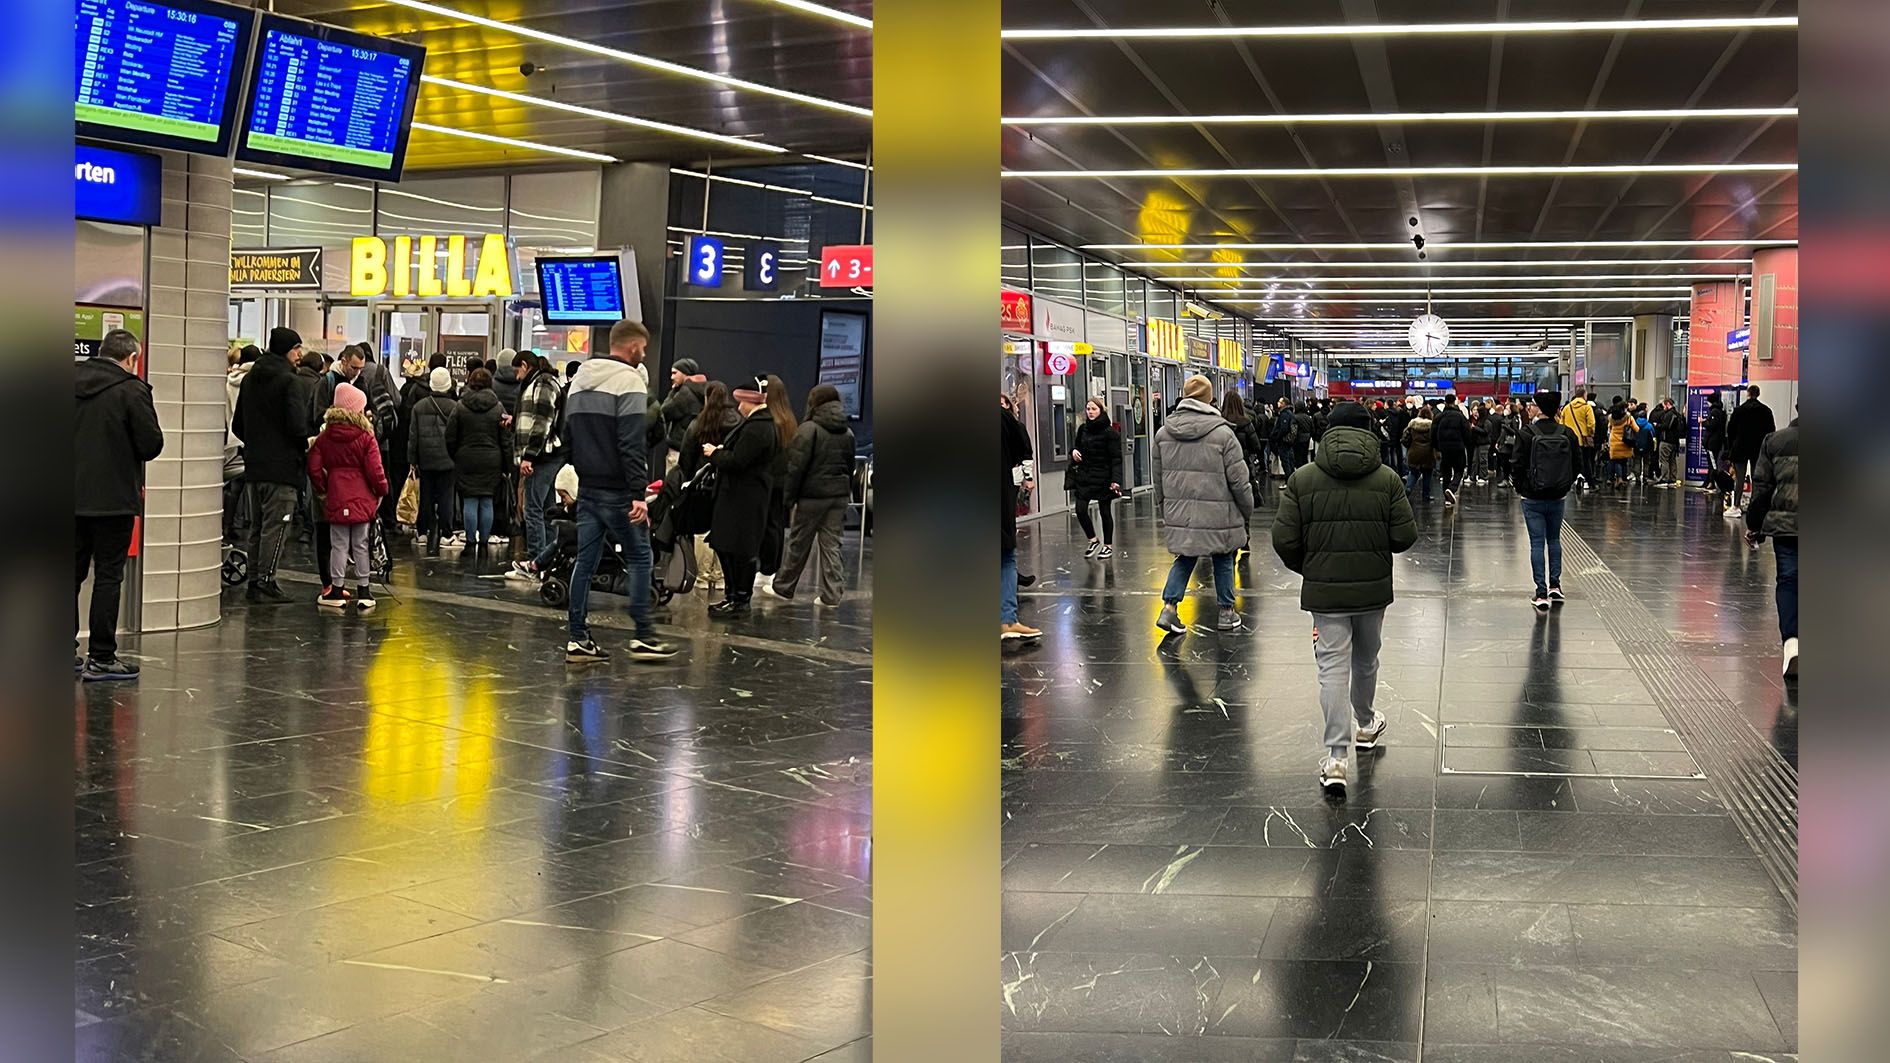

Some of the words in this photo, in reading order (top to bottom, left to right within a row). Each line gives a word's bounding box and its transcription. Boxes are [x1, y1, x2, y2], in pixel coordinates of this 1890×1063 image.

[125, 1, 155, 14] Departure
[167, 10, 196, 24] 15:30:16
[279, 34, 302, 46] Abfahrt
[317, 42, 342, 54] Departure
[352, 49, 377, 61] 15:30:17
[75, 161, 115, 184] rten
[233, 255, 289, 269] WILLKOMMEN
[290, 255, 301, 269] IM
[351, 234, 512, 297] BILLA
[698, 244, 716, 280] 3
[250, 269, 301, 282] PRATERSTERN
[1147, 317, 1185, 363] BILLA
[75, 342, 90, 354] ets
